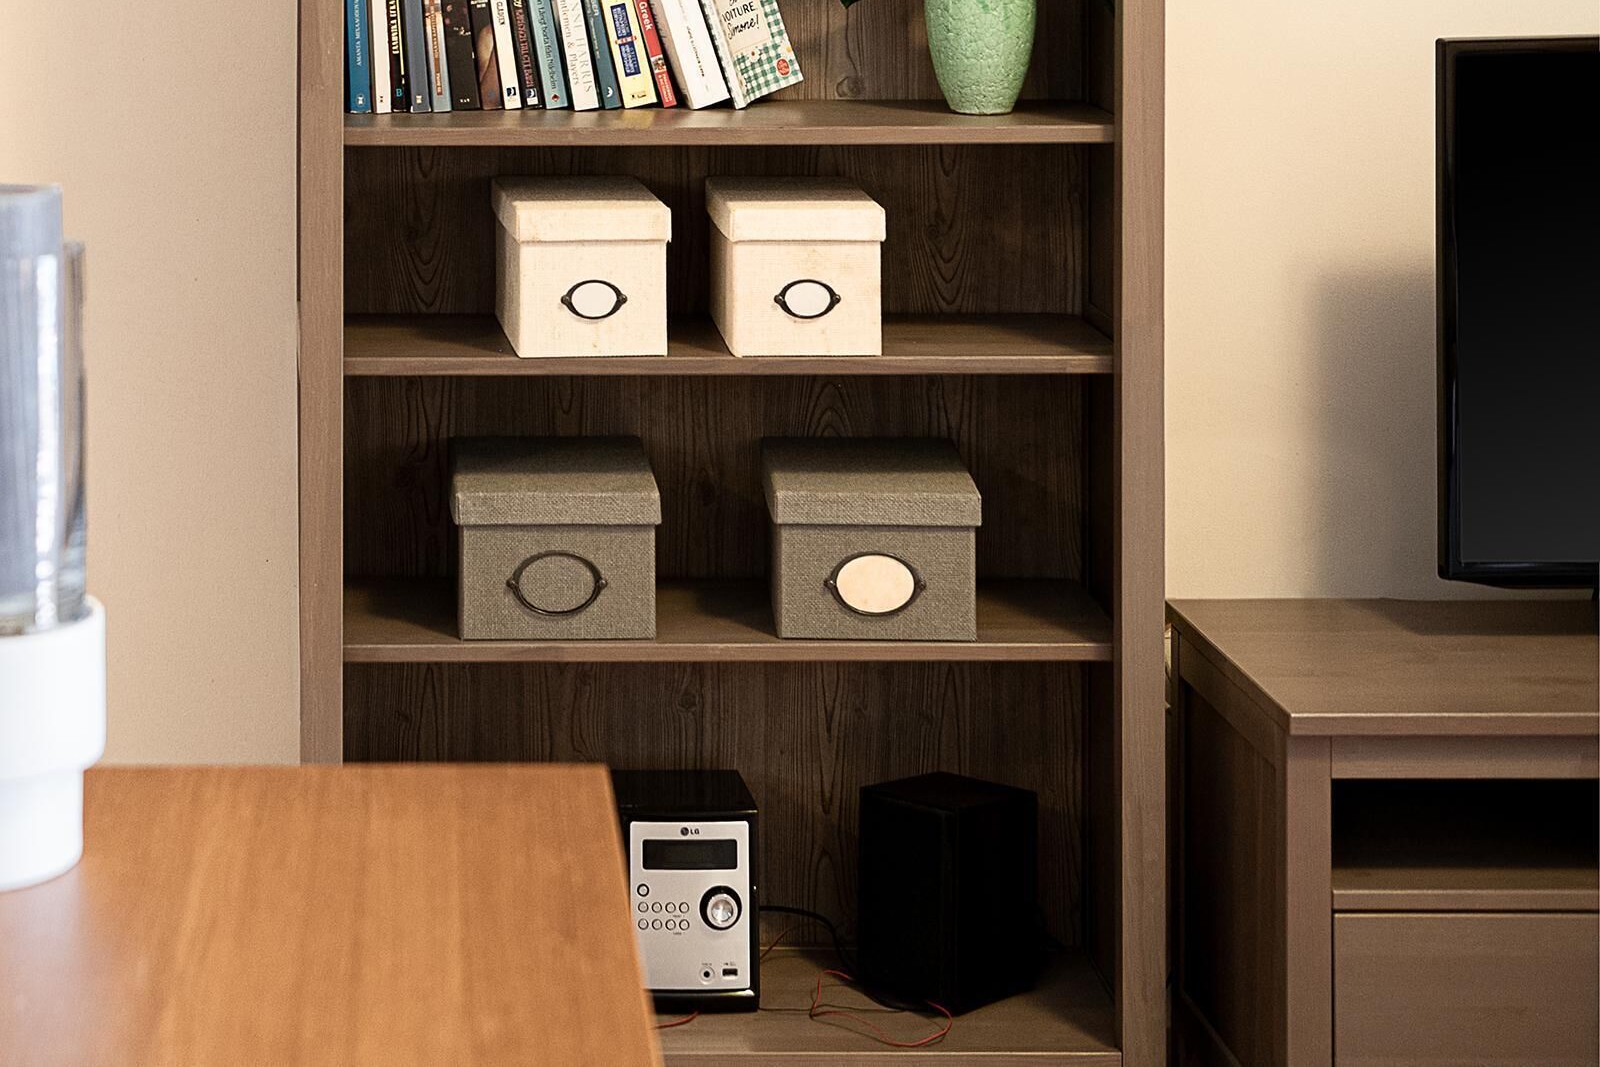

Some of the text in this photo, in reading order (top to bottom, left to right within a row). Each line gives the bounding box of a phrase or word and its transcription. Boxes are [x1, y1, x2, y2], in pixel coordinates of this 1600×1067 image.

[638, 1, 652, 31] Greek
[567, 41, 575, 49] &
[568, 53, 581, 86] Players
[576, 38, 593, 94] HARRIS
